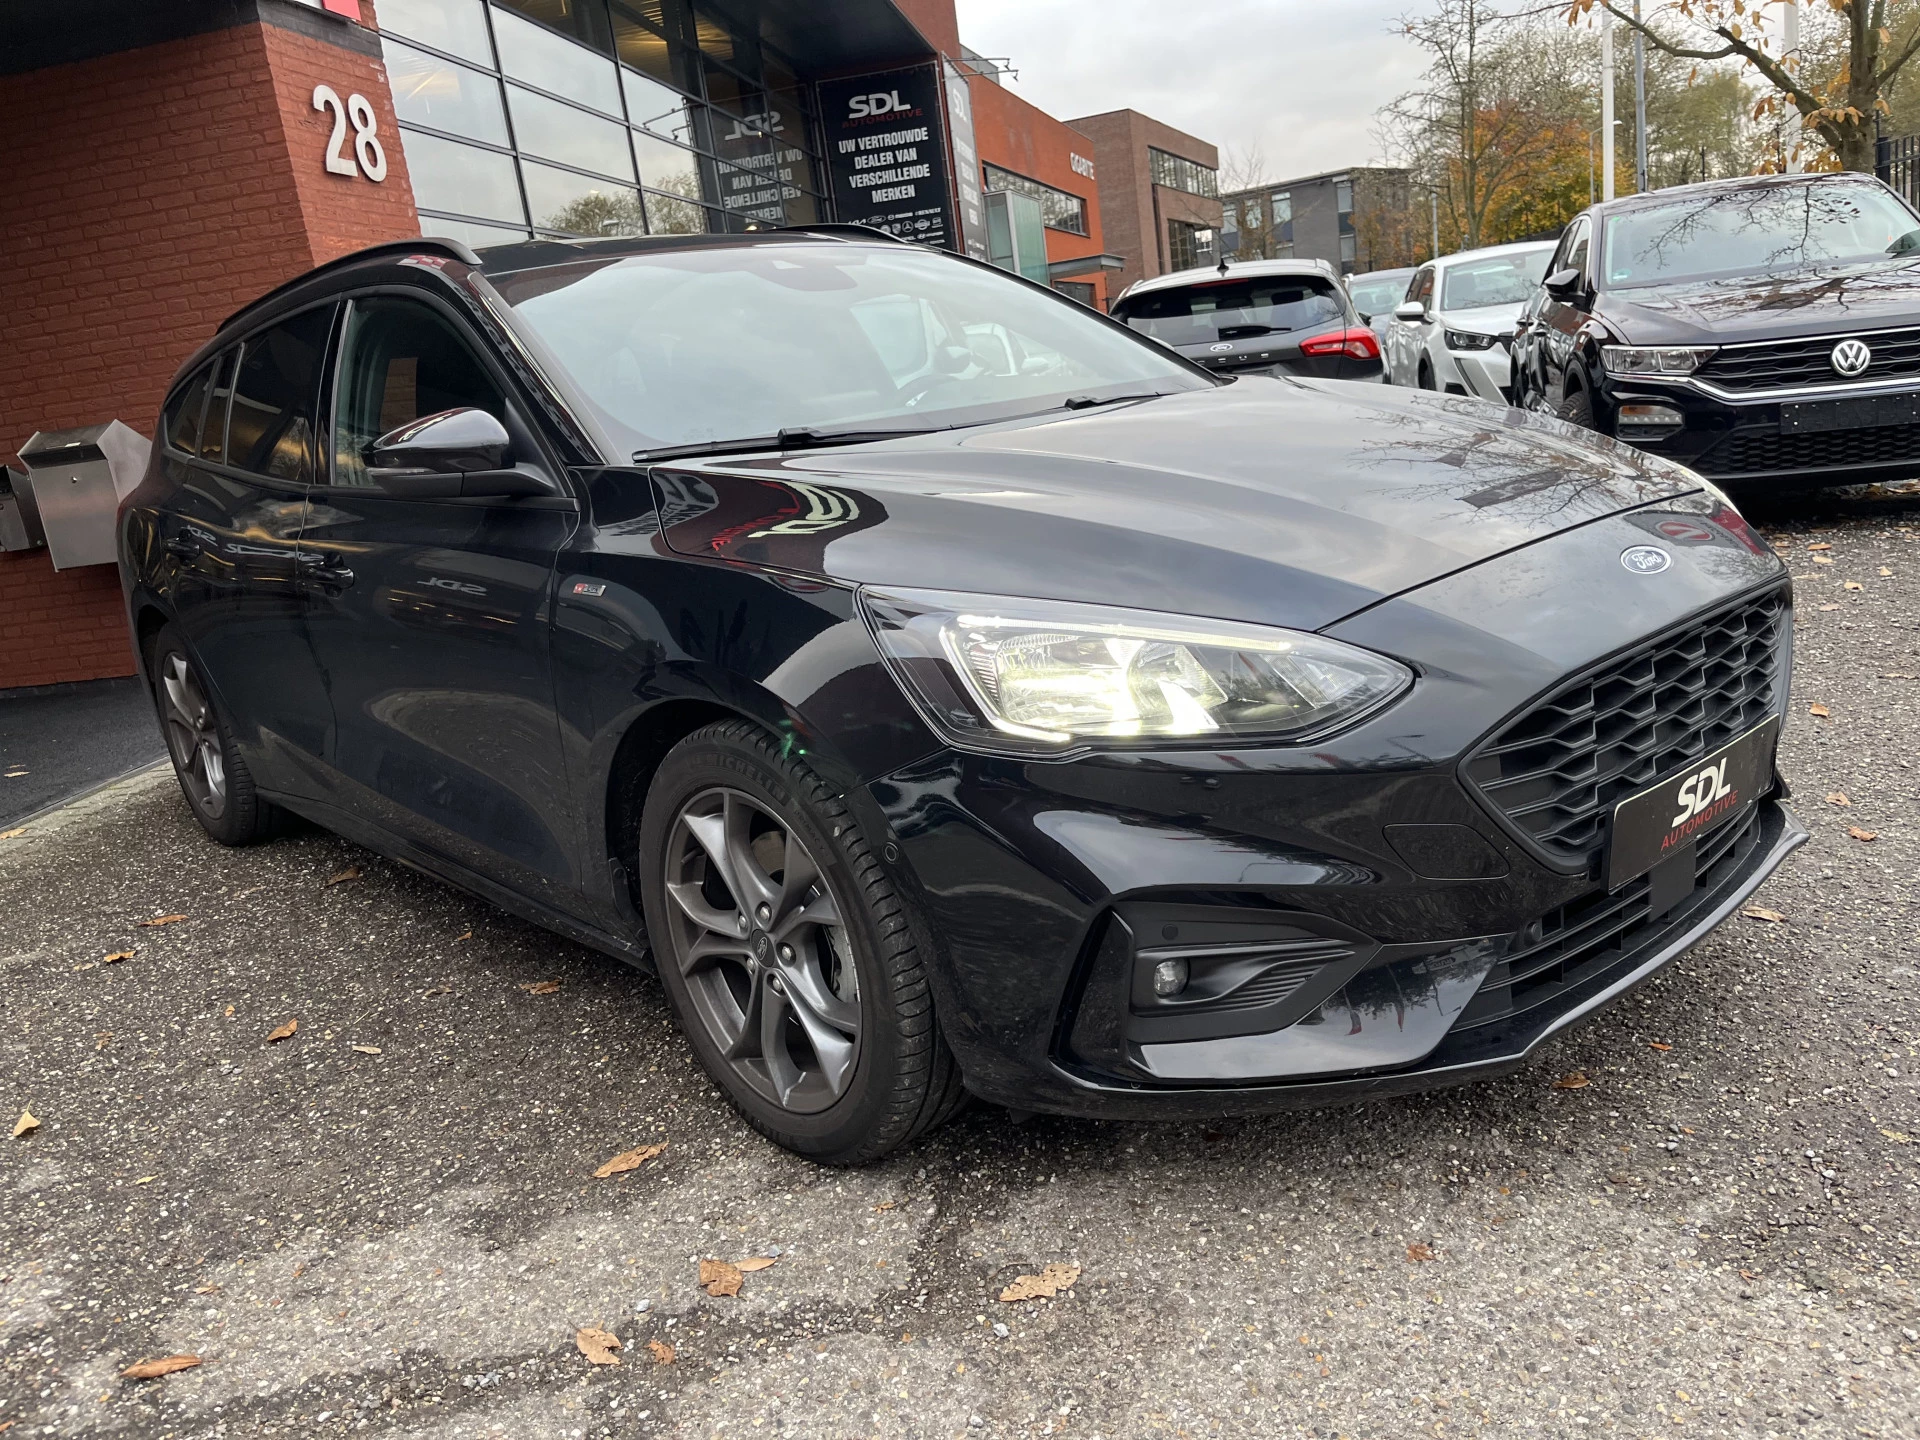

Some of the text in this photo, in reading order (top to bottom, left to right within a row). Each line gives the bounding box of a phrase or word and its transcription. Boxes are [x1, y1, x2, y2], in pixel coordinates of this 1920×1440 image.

[848, 90, 912, 119] SDL
[842, 108, 923, 128] AUTOMOTIVE
[312, 84, 387, 182] 28
[838, 127, 929, 153] UW VERTROUWDE
[854, 147, 918, 170] DEALER VAN
[849, 164, 931, 189] VERSCHILLENDE
[871, 184, 916, 204] MERKEN
[1631, 551, 1662, 570] Ford
[1671, 756, 1731, 828] SDL
[1659, 789, 1739, 851] AUTOMOTIVE
